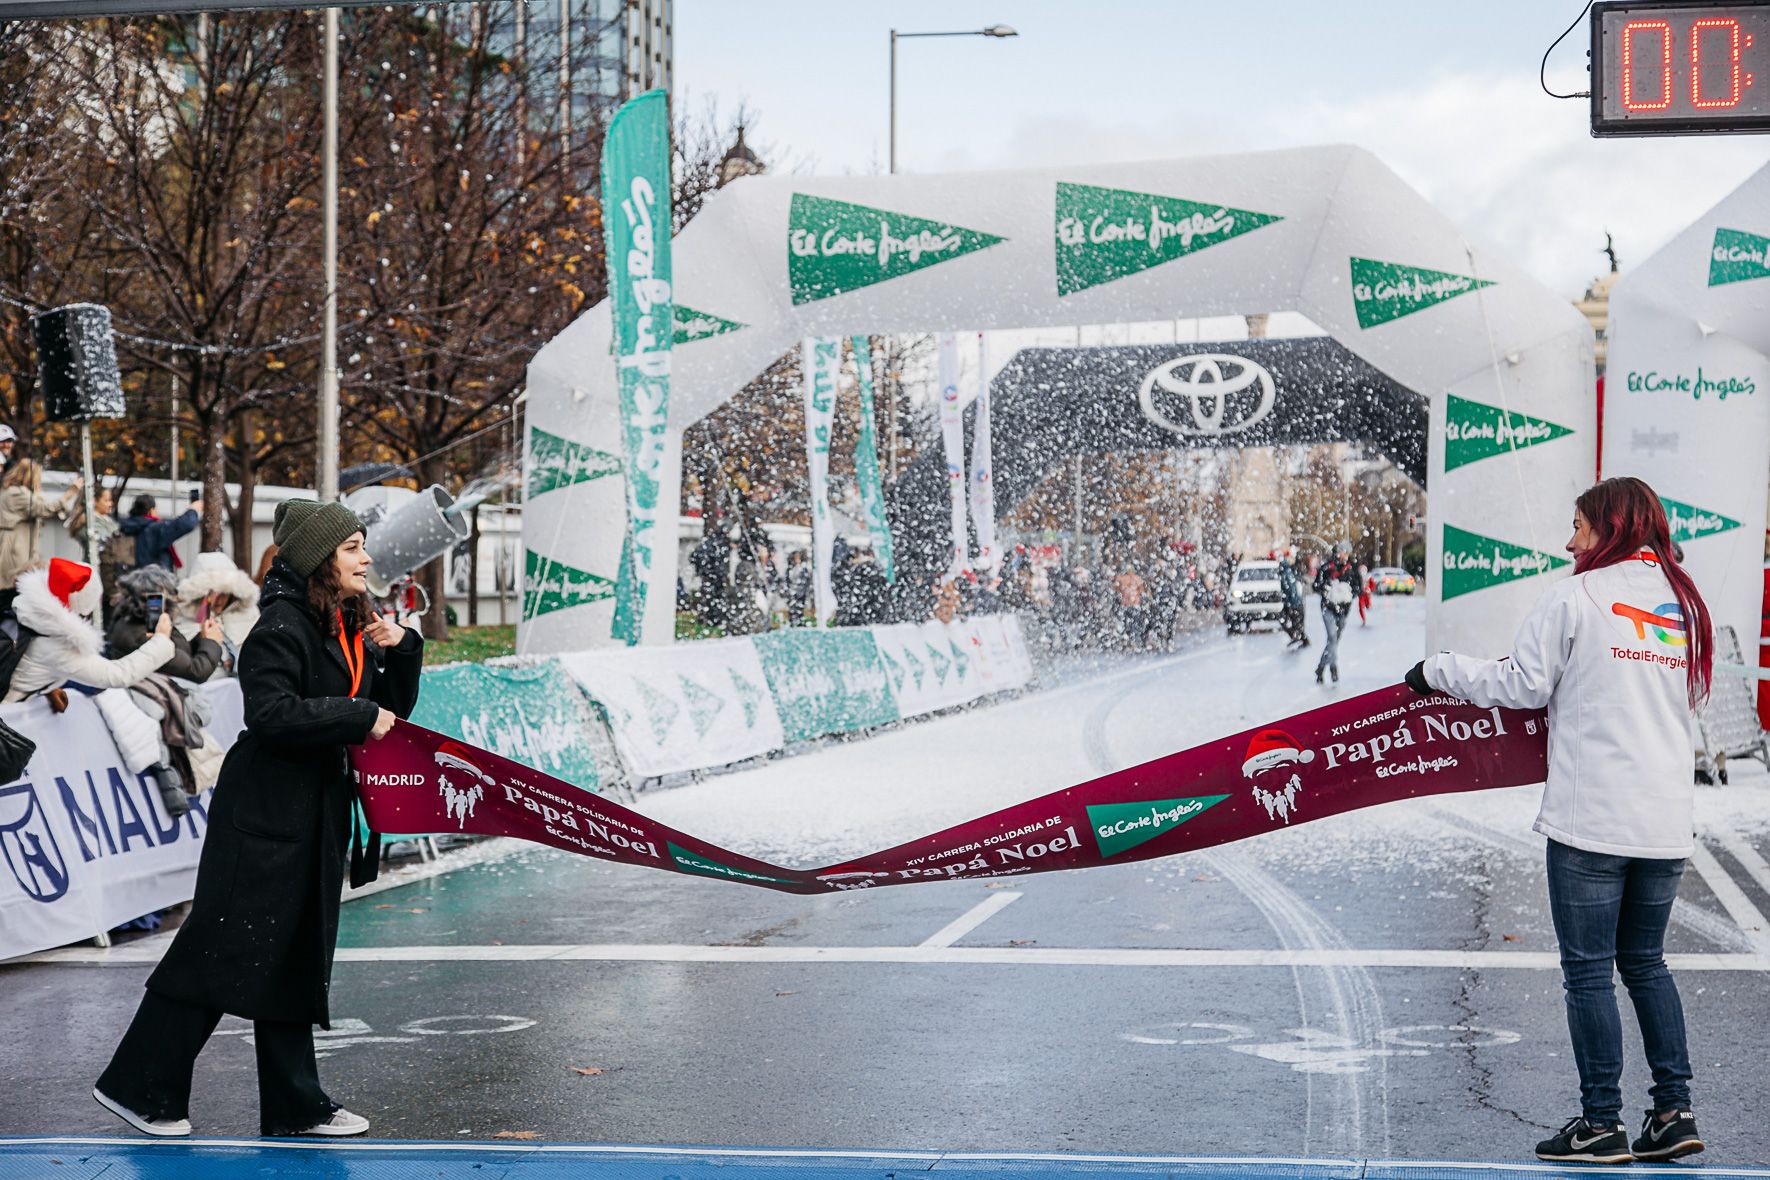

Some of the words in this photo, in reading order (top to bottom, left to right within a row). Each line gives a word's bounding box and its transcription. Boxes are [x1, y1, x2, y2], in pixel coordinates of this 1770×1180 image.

[791, 228, 818, 256] El
[821, 226, 876, 256] Corte
[878, 221, 962, 266] Inglés
[1058, 216, 1085, 245] El
[1089, 214, 1146, 243] Corte
[1149, 205, 1235, 250] Inglés
[1713, 246, 1728, 261] El
[1728, 246, 1763, 263] Corte
[620, 175, 672, 378] Inglés
[1627, 371, 1642, 392] El
[1644, 372, 1690, 392] Corte
[1693, 366, 1756, 400] Inglés
[1446, 421, 1460, 440] El
[1460, 421, 1495, 440] Corte
[1496, 415, 1552, 445] Inglés
[1443, 550, 1457, 570] El
[1457, 550, 1492, 570] Corte
[1491, 546, 1550, 576] Inglés
[1611, 647, 1688, 670] TotalEnergie
[1331, 723, 1351, 737] XIV
[1353, 707, 1407, 730] CARRERA
[1409, 696, 1468, 712] SOLIDARIA
[1320, 719, 1416, 771] Papá
[1420, 706, 1508, 743] Noel
[366, 773, 425, 786] MADRID
[1376, 766, 1391, 778] El
[1389, 760, 1418, 776] Corte
[1418, 755, 1458, 775] Inglés
[501, 782, 580, 832] Papá
[585, 818, 661, 859] Noel
[510, 777, 526, 788] XIV
[528, 785, 575, 809] CARRERA
[576, 804, 629, 831] SOLIDARIA
[630, 826, 645, 837] DE
[1098, 825, 1116, 838] El
[1115, 814, 1151, 833] Corte
[1151, 800, 1203, 827] Inglés
[897, 853, 990, 879] Papá
[996, 825, 1082, 864] Noel
[906, 856, 925, 867] XIV
[928, 842, 981, 862] CARRERA
[983, 822, 1044, 847] SOLIDARIA
[1045, 815, 1062, 827] DE
